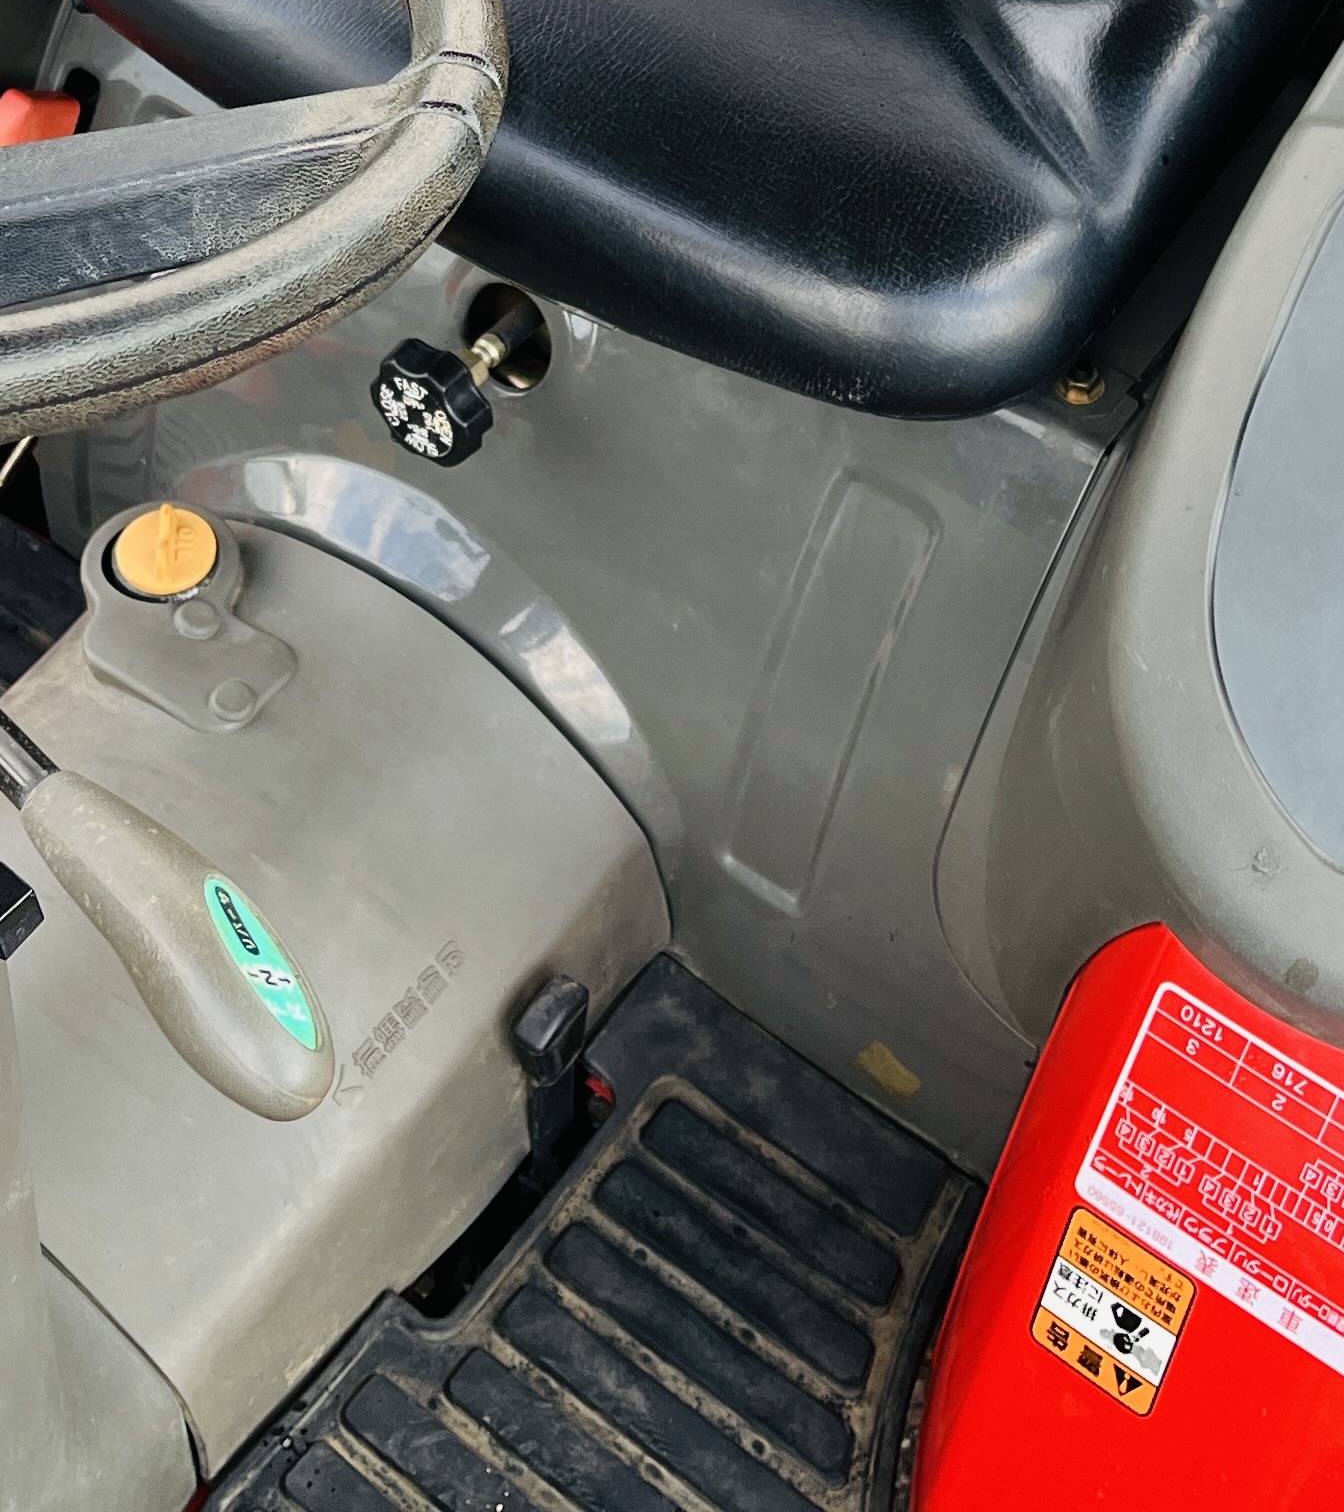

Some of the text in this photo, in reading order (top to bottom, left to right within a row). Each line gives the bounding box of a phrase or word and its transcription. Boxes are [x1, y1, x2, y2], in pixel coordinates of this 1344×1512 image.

[393, 377, 429, 400] FAST
[379, 384, 400, 426] CLOSE
[433, 410, 453, 448] OPEN
[405, 431, 438, 457] SLOW
[175, 527, 194, 561] OIL
[1178, 1004, 1224, 1041] 1210
[1183, 1037, 1201, 1056] 3
[1271, 1062, 1308, 1095] 716
[1269, 1092, 1287, 1111] 2
[1117, 1122, 1131, 1137] 4
[1137, 1136, 1151, 1150] 3
[1157, 1149, 1170, 1163] 2
[1090, 1152, 1143, 1197] トレーラ
[1139, 1165, 1152, 1178] 2
[1178, 1164, 1189, 1176] 1
[1303, 1167, 1318, 1183] 4
[1203, 1179, 1216, 1193] 4
[1251, 1174, 1262, 1186] 1
[1324, 1181, 1338, 1196] 3
[1143, 1189, 1180, 1221] 代カキ
[1222, 1193, 1236, 1207] 3
[1242, 1205, 1256, 1220] 2
[1225, 1224, 1235, 1235] 1
[1265, 1221, 1276, 1234] 1
[1233, 1248, 1289, 1292] ロータリ
[1057, 1261, 1102, 1303] に注意
[1049, 1280, 1097, 1321] 排ガス
